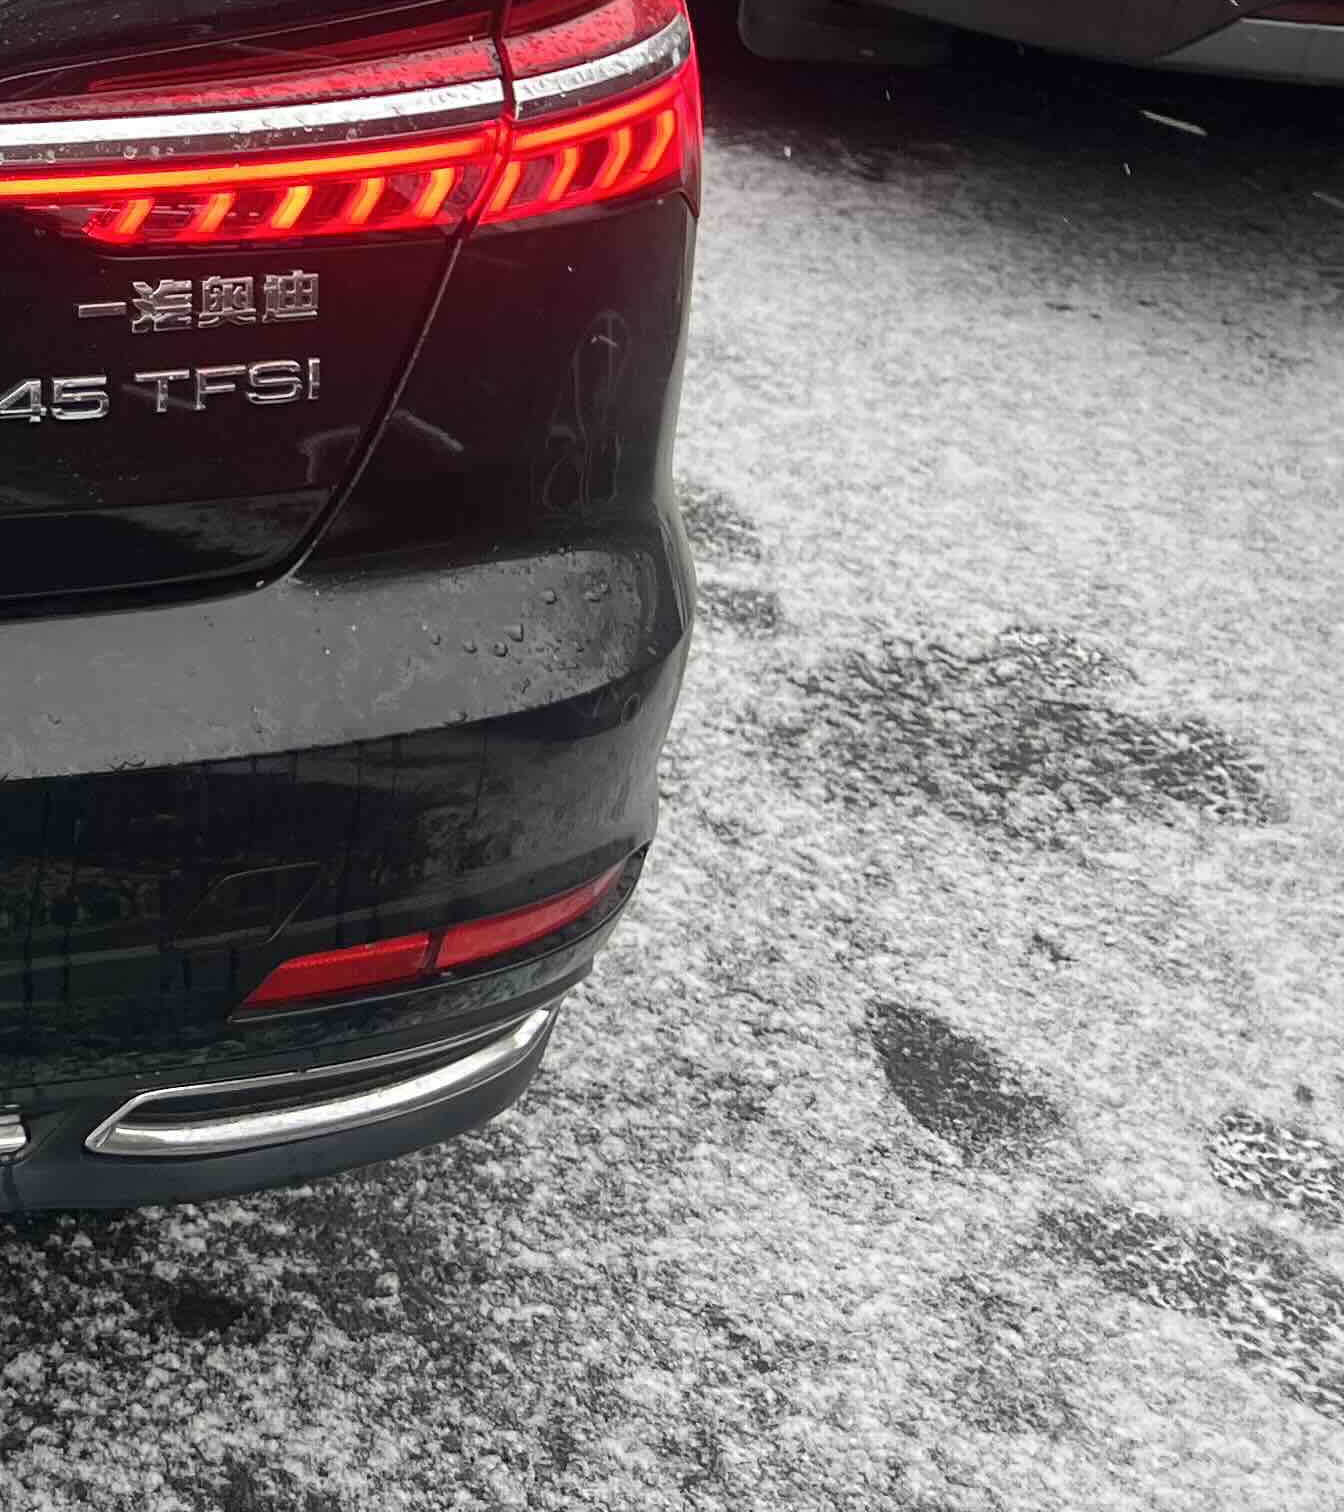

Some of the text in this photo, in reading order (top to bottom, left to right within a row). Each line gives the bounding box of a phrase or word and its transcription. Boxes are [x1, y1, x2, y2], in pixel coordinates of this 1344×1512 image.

[78, 270, 320, 334] 一汽奥迪
[134, 357, 321, 413] TFSI
